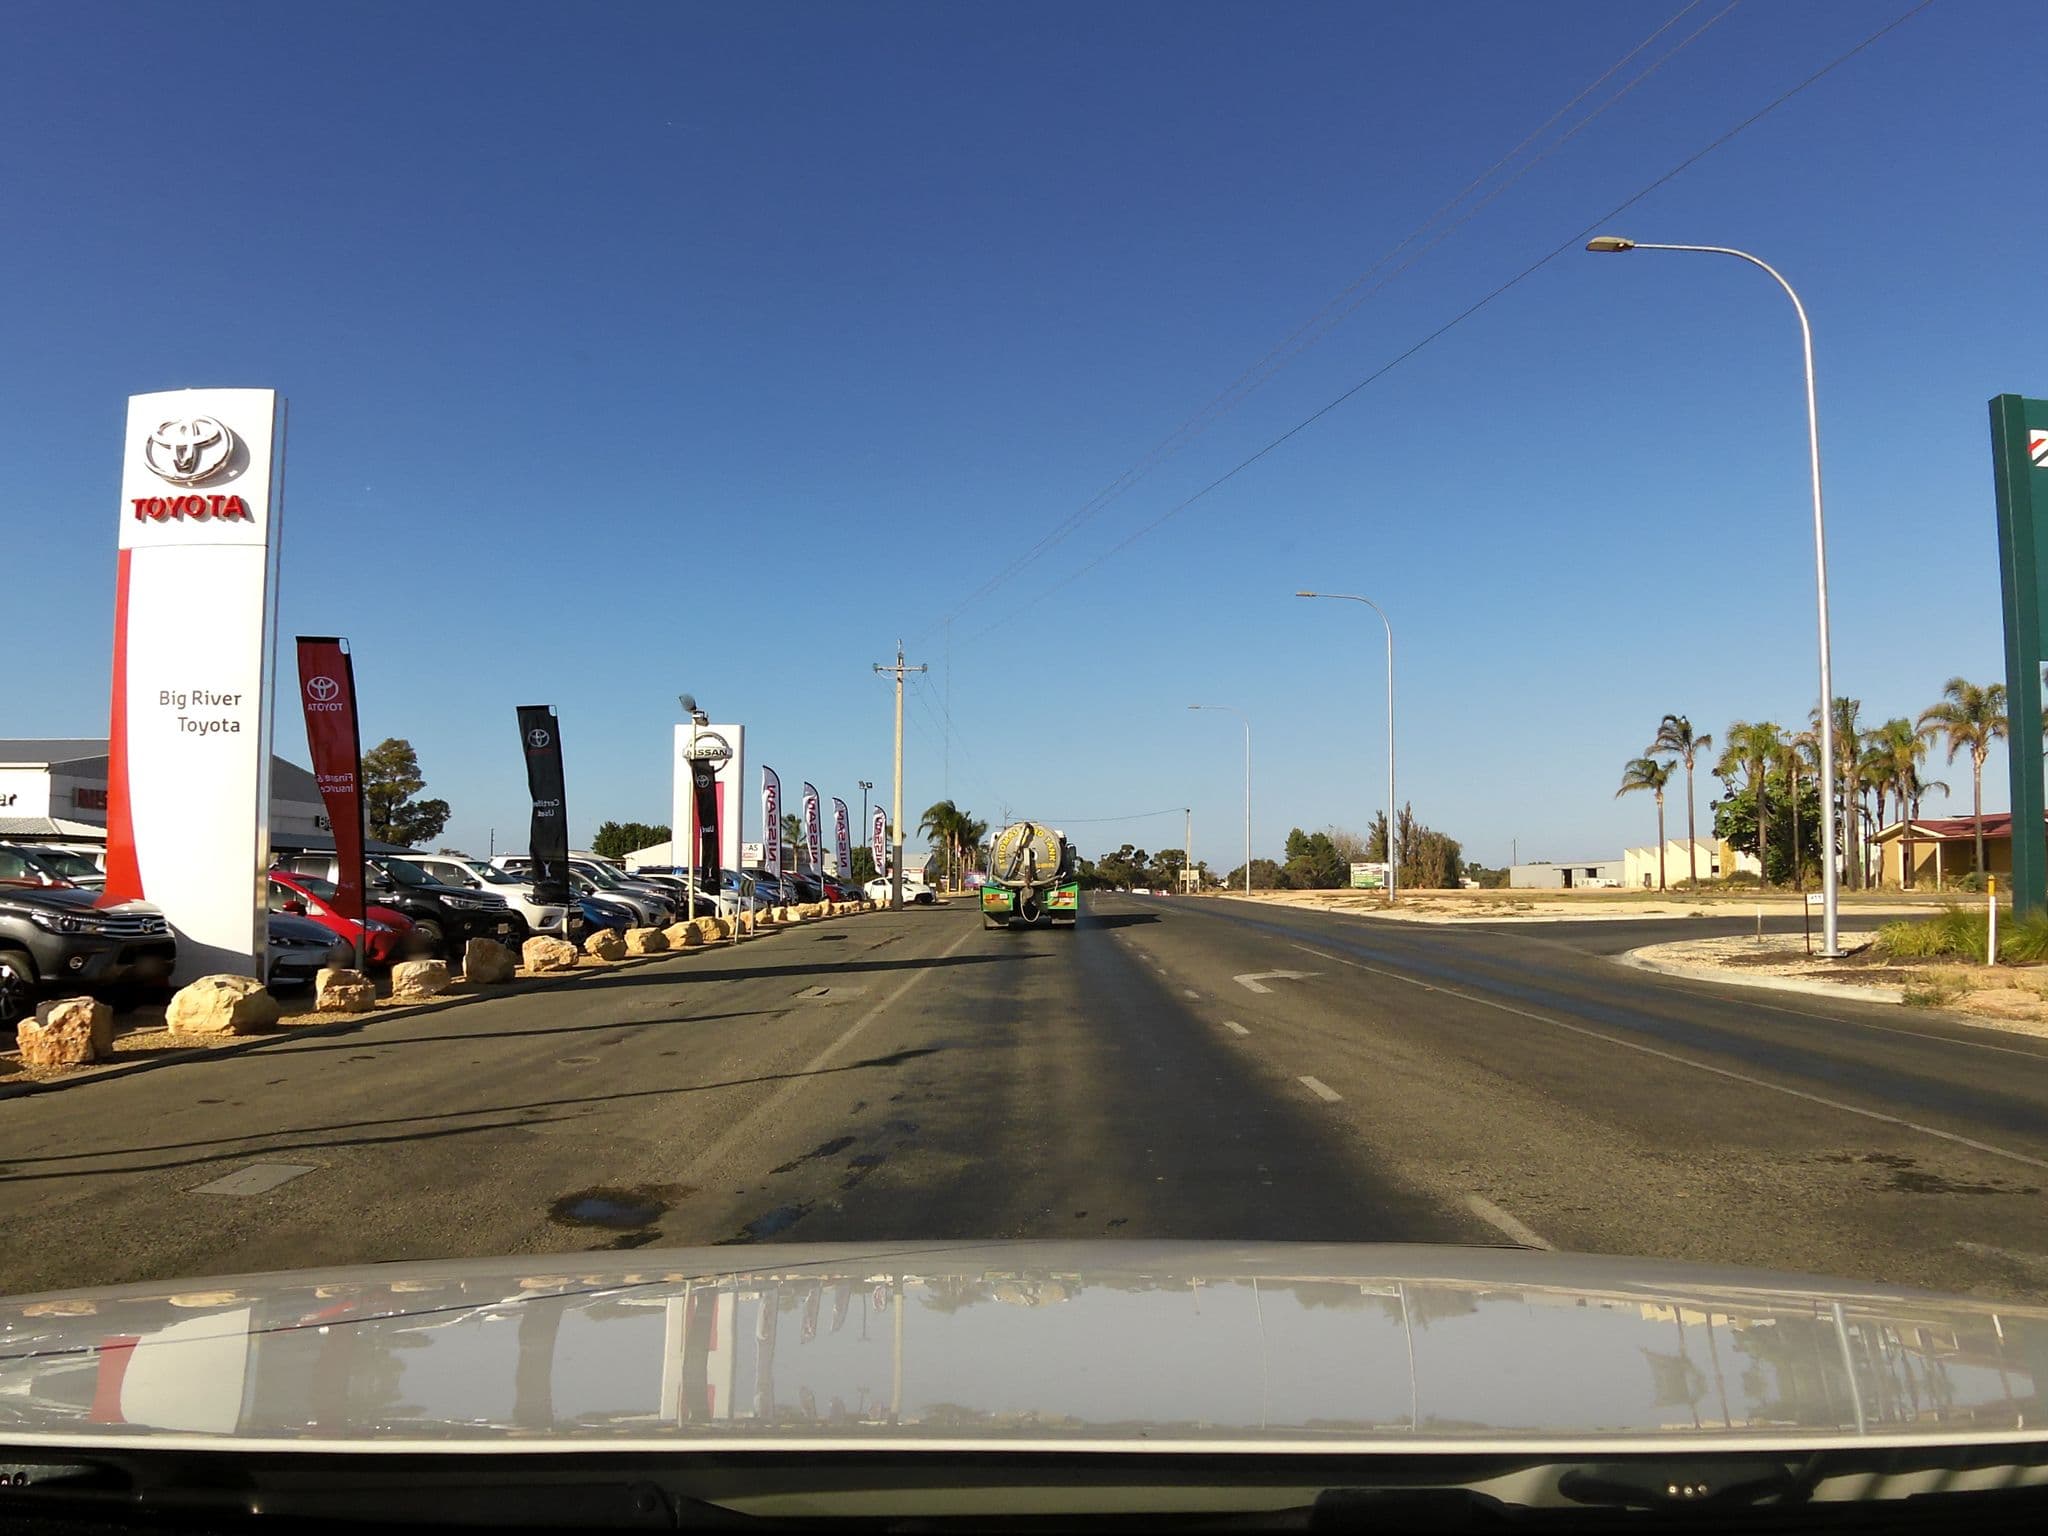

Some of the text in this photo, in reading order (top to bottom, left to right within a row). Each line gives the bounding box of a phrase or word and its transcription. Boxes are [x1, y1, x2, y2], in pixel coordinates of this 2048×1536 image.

[131, 495, 247, 521] TOYOTA
[160, 690, 242, 709] Big River
[177, 716, 241, 736] Toyota
